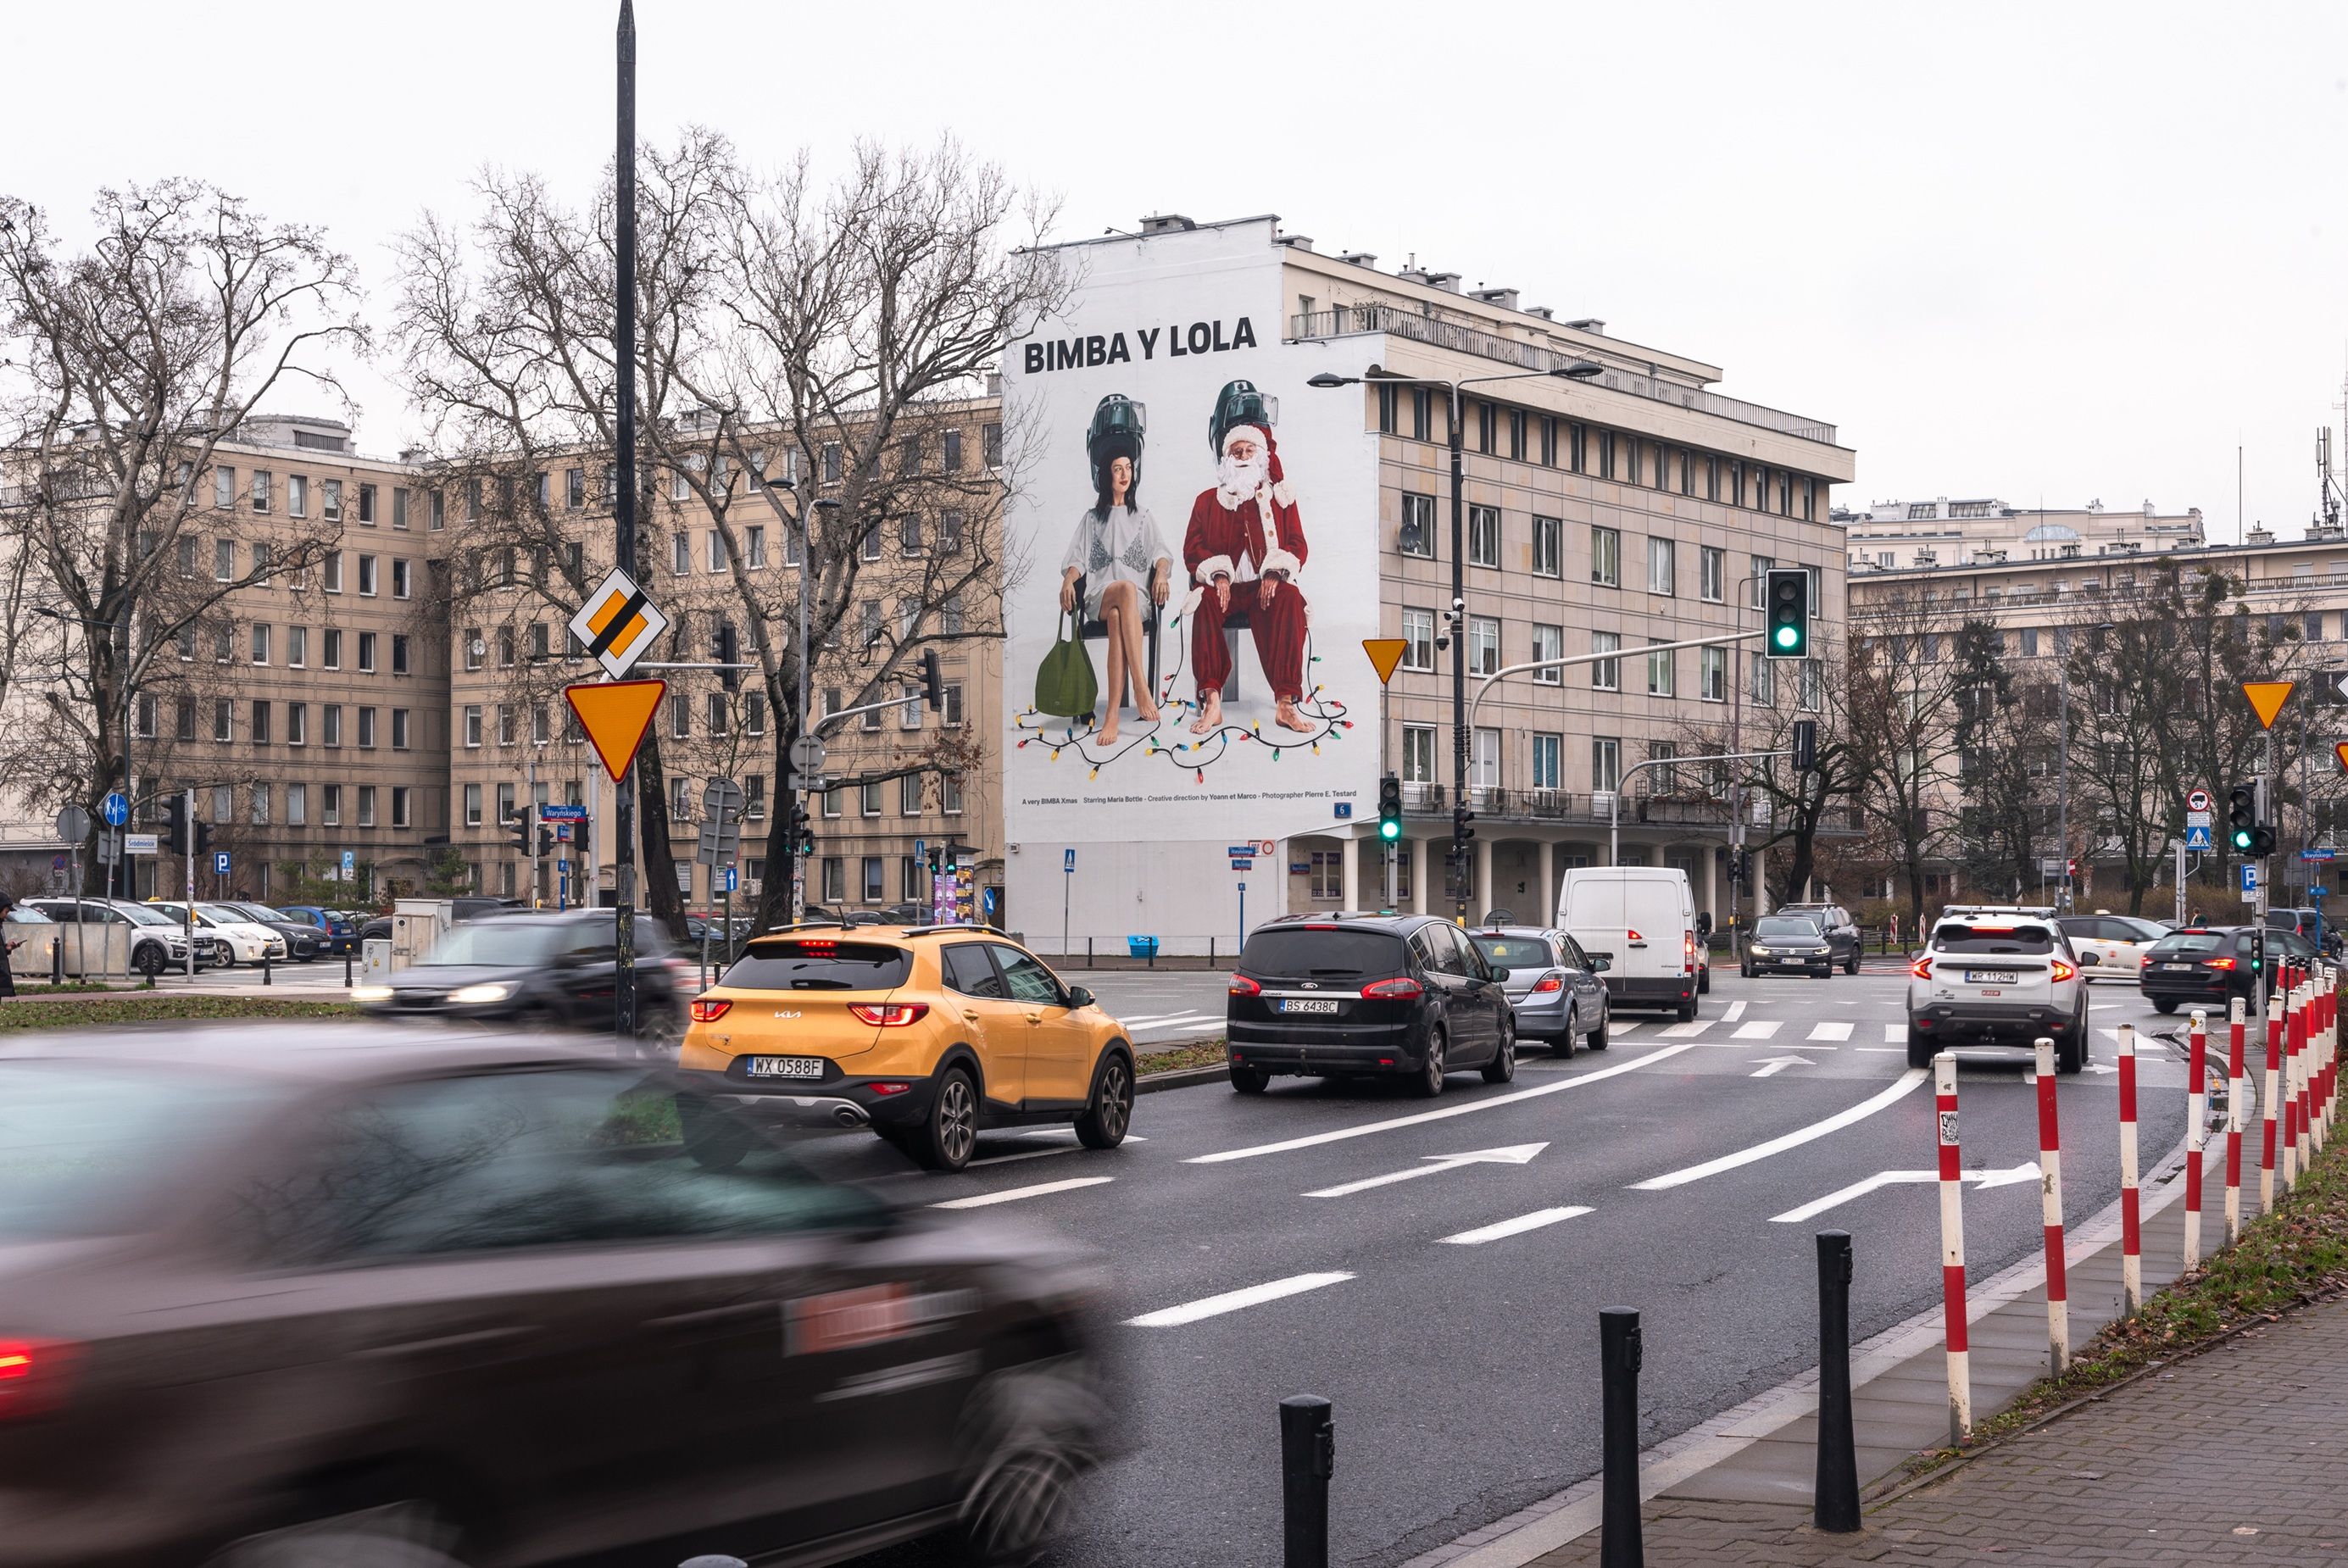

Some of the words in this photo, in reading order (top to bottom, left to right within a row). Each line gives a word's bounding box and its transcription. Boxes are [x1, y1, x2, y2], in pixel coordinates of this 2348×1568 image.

[1025, 331, 1131, 375] BIMBA
[1137, 327, 1160, 360] Y
[1170, 316, 1257, 358] LOLA
[1083, 796, 1106, 804] Starring
[1173, 793, 1199, 802] direction
[1261, 792, 1304, 800] Photographer
[546, 809, 581, 818] Waryńskiego
[1339, 806, 1345, 815] 6
[218, 854, 228, 871] P
[1971, 972, 1984, 981] WR
[1987, 972, 2015, 981] 112HW
[1286, 1001, 1300, 1011] BS
[1303, 1001, 1336, 1012] 6438C
[755, 1059, 772, 1073] WX
[777, 1059, 821, 1075] 0588F
